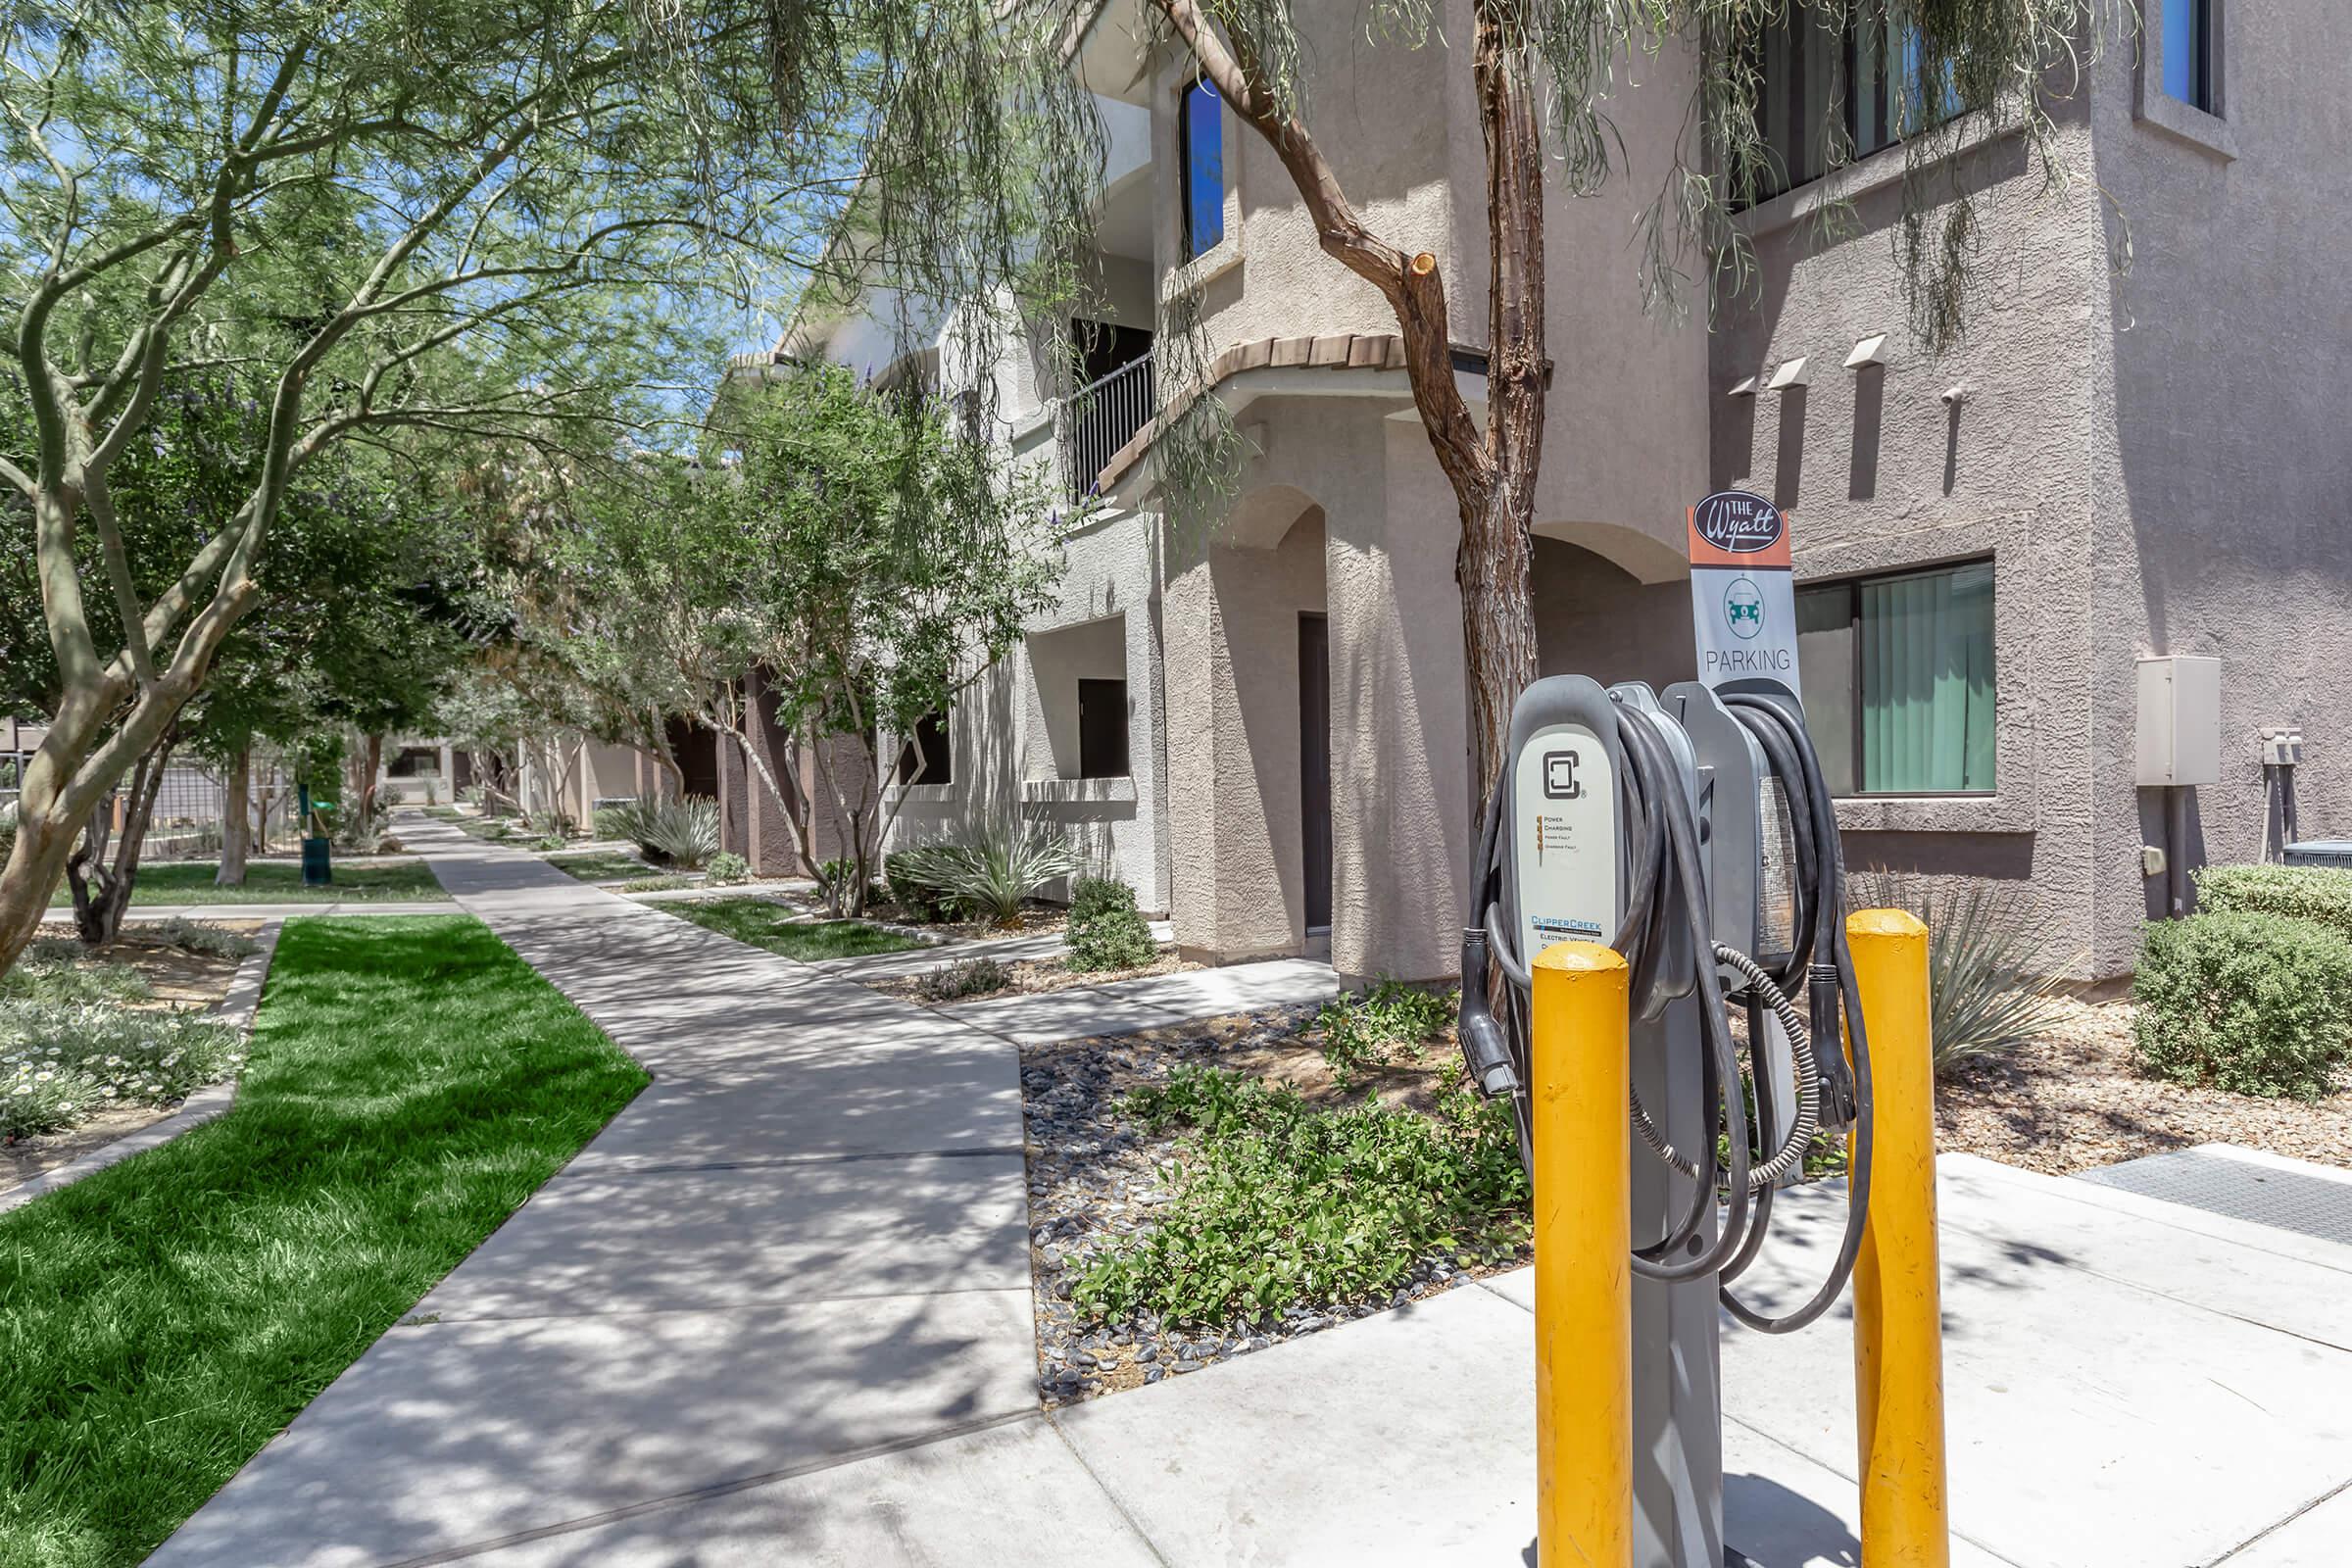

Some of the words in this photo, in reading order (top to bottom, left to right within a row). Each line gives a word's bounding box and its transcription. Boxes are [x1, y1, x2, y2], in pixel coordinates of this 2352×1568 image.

[1730, 501, 1753, 515] THE
[1707, 501, 1774, 552] Wyatt
[1706, 650, 1790, 672] PARKING
